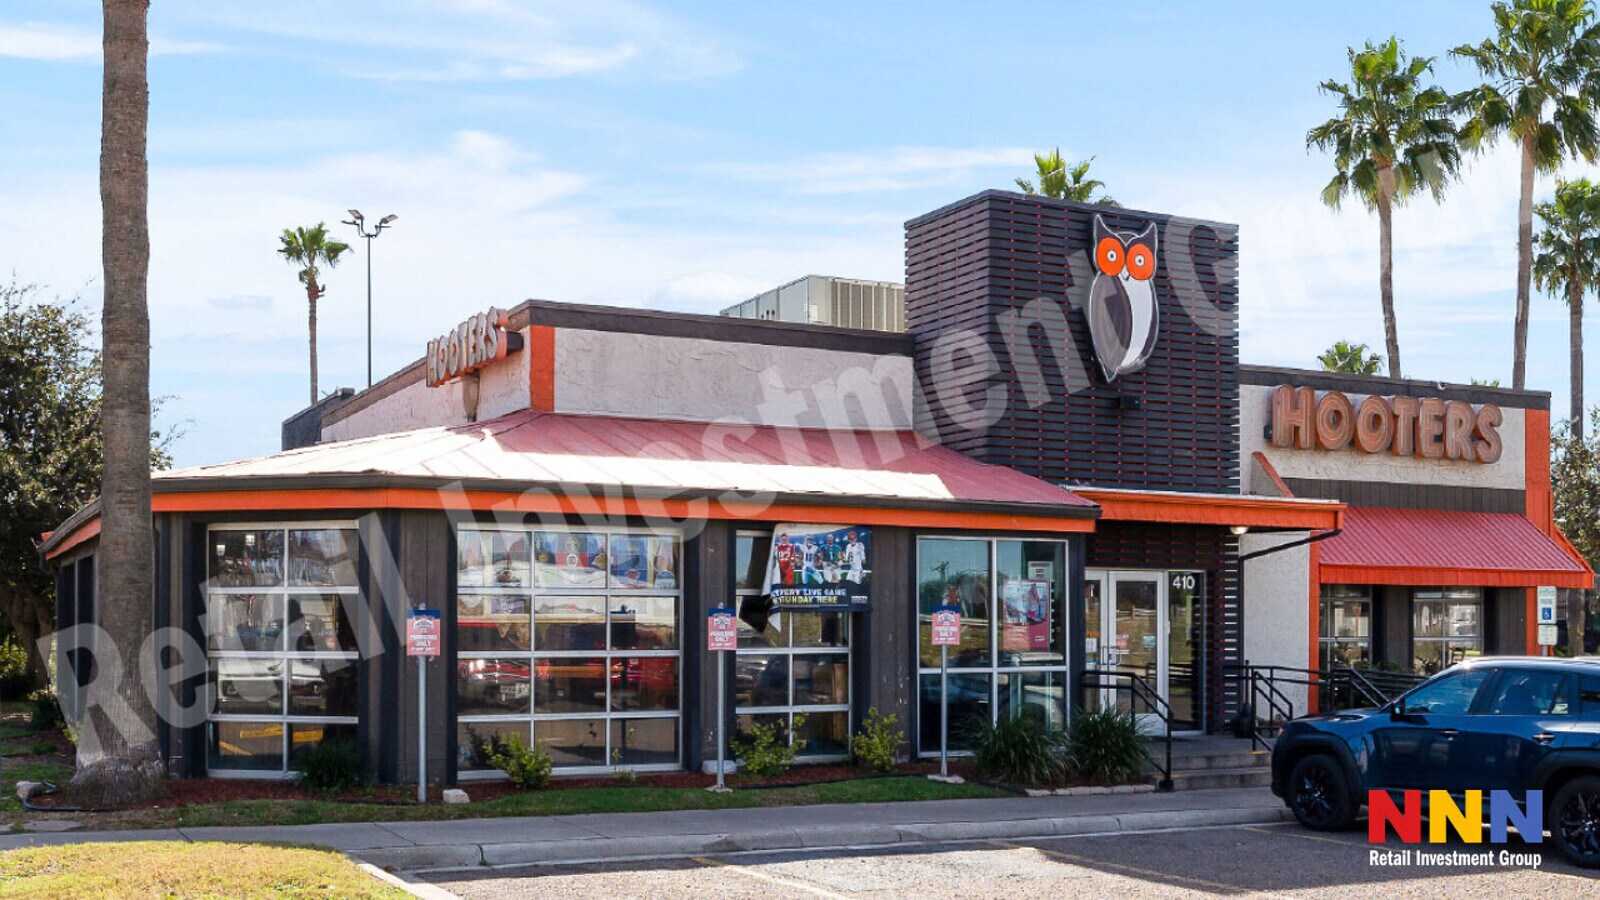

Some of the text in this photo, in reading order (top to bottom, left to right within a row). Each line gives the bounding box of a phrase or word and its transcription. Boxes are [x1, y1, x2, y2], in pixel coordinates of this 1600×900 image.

[426, 306, 508, 387] HOOTERS
[1272, 384, 1503, 464] HOOTERS
[1172, 575, 1196, 589] 410
